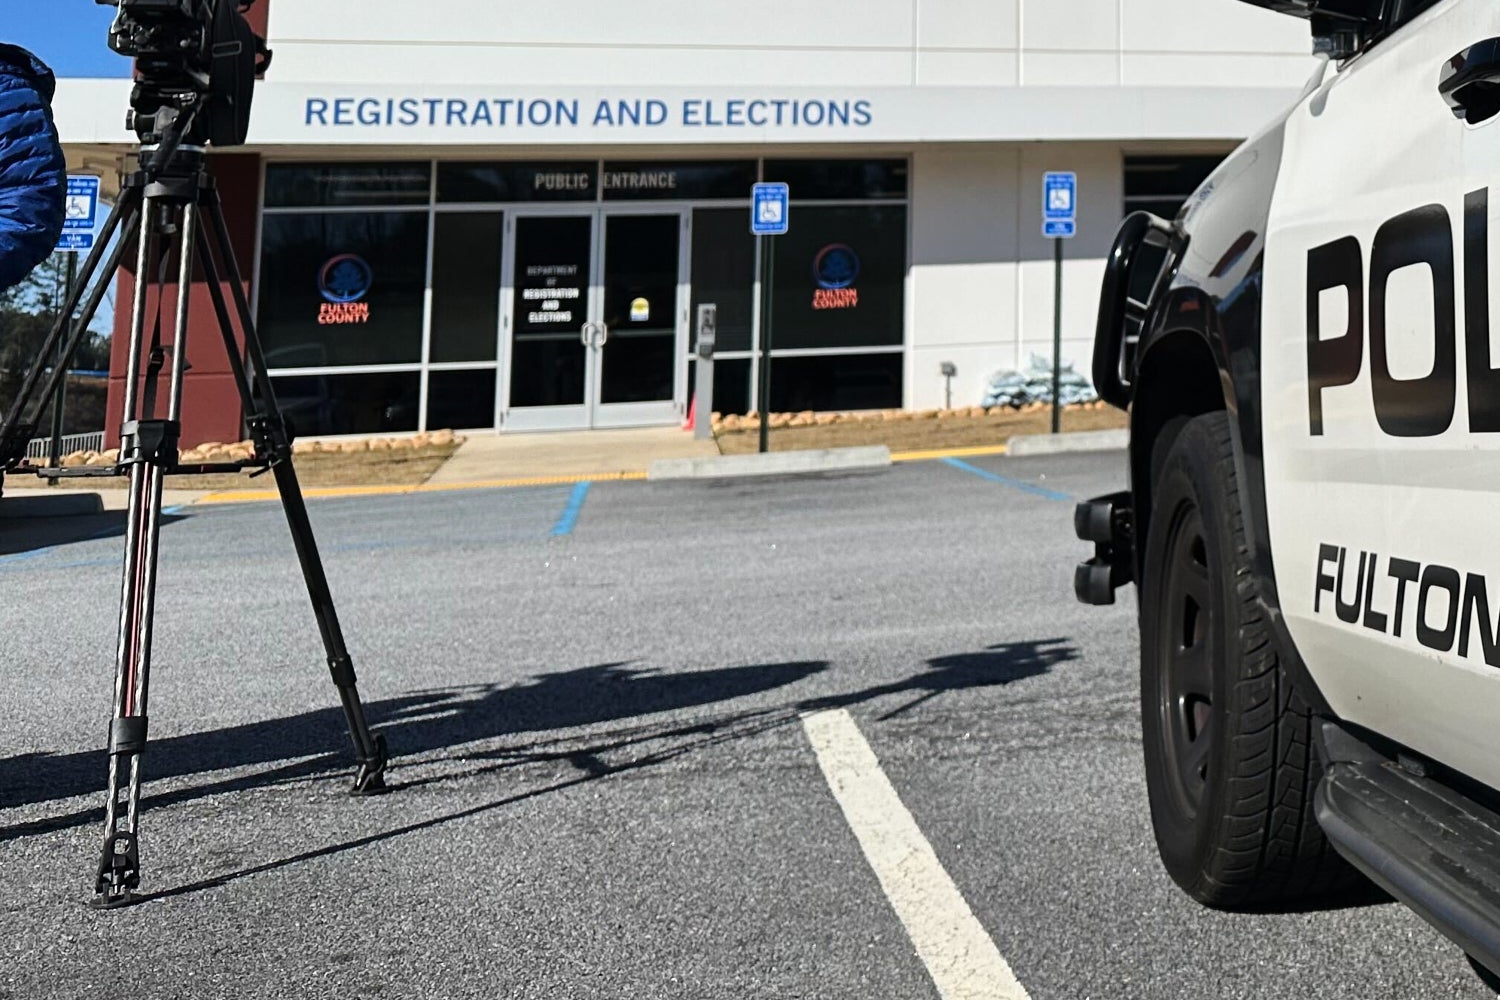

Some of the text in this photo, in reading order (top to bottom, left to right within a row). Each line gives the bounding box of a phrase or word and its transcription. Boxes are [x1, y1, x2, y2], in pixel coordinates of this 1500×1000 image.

[304, 97, 873, 126] REGISTRATION AND ELECTIONS
[534, 171, 676, 189] PUBLIC ENTRANCE
[523, 288, 579, 299] REGISTRATION
[814, 288, 857, 299] FULTON
[320, 302, 369, 313] FULTON
[542, 300, 559, 310] AND
[317, 312, 370, 324] COUNTY
[528, 311, 572, 323] ELECTIONS
